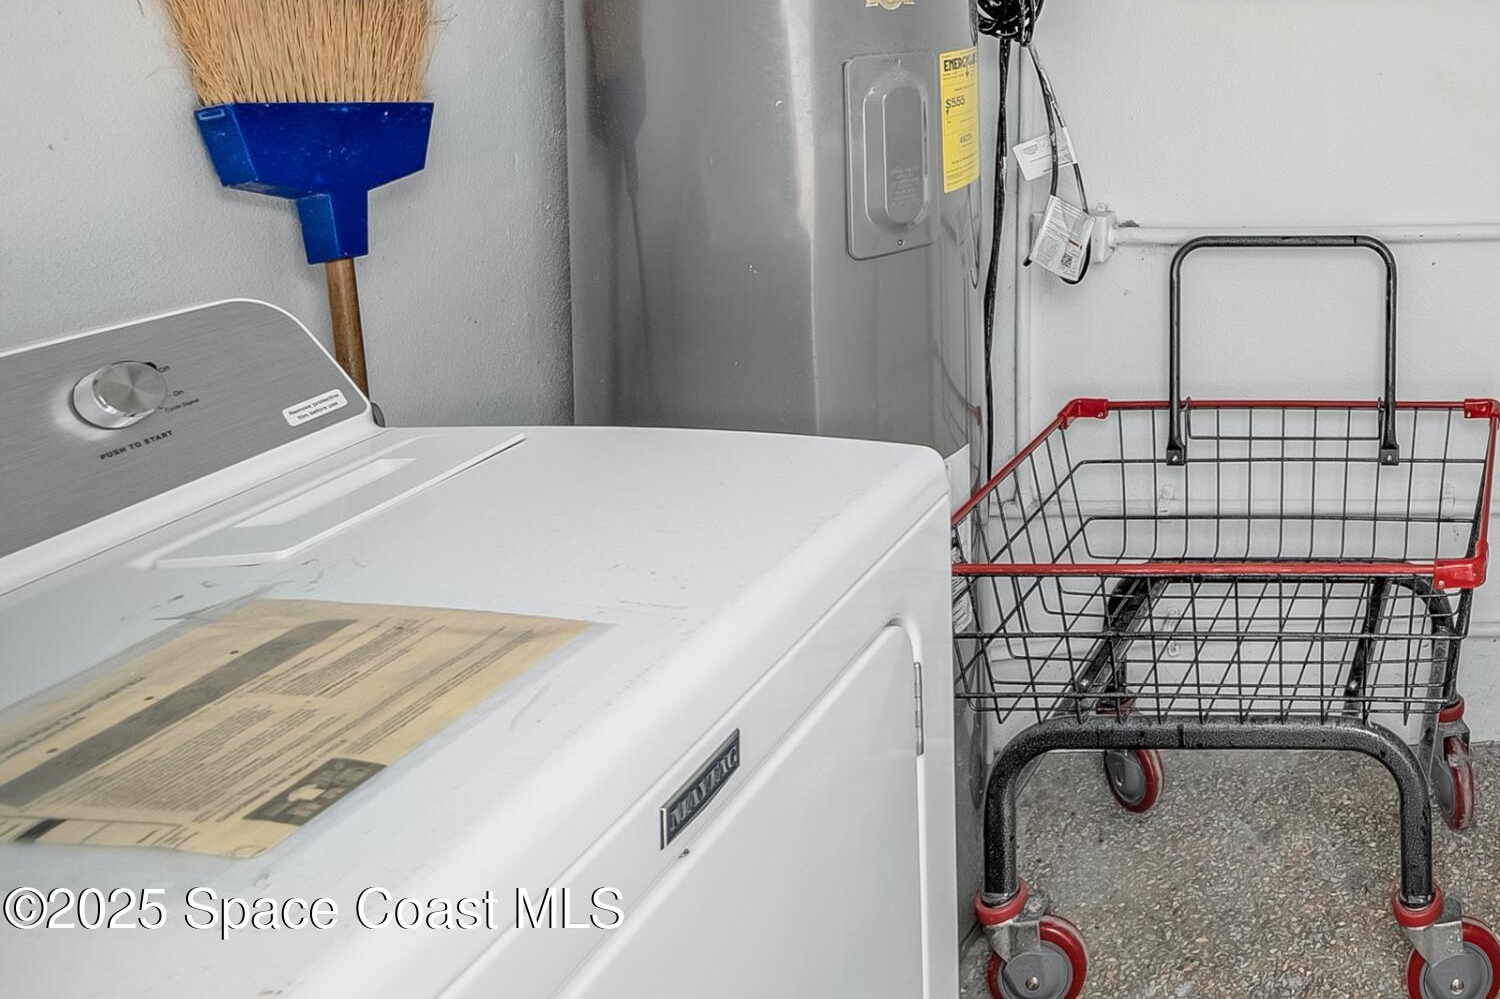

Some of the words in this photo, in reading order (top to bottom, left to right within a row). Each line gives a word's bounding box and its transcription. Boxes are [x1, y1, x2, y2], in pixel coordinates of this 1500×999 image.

[99, 447, 127, 460] PUSH
[128, 442, 142, 450] TO
[144, 430, 173, 445] START
